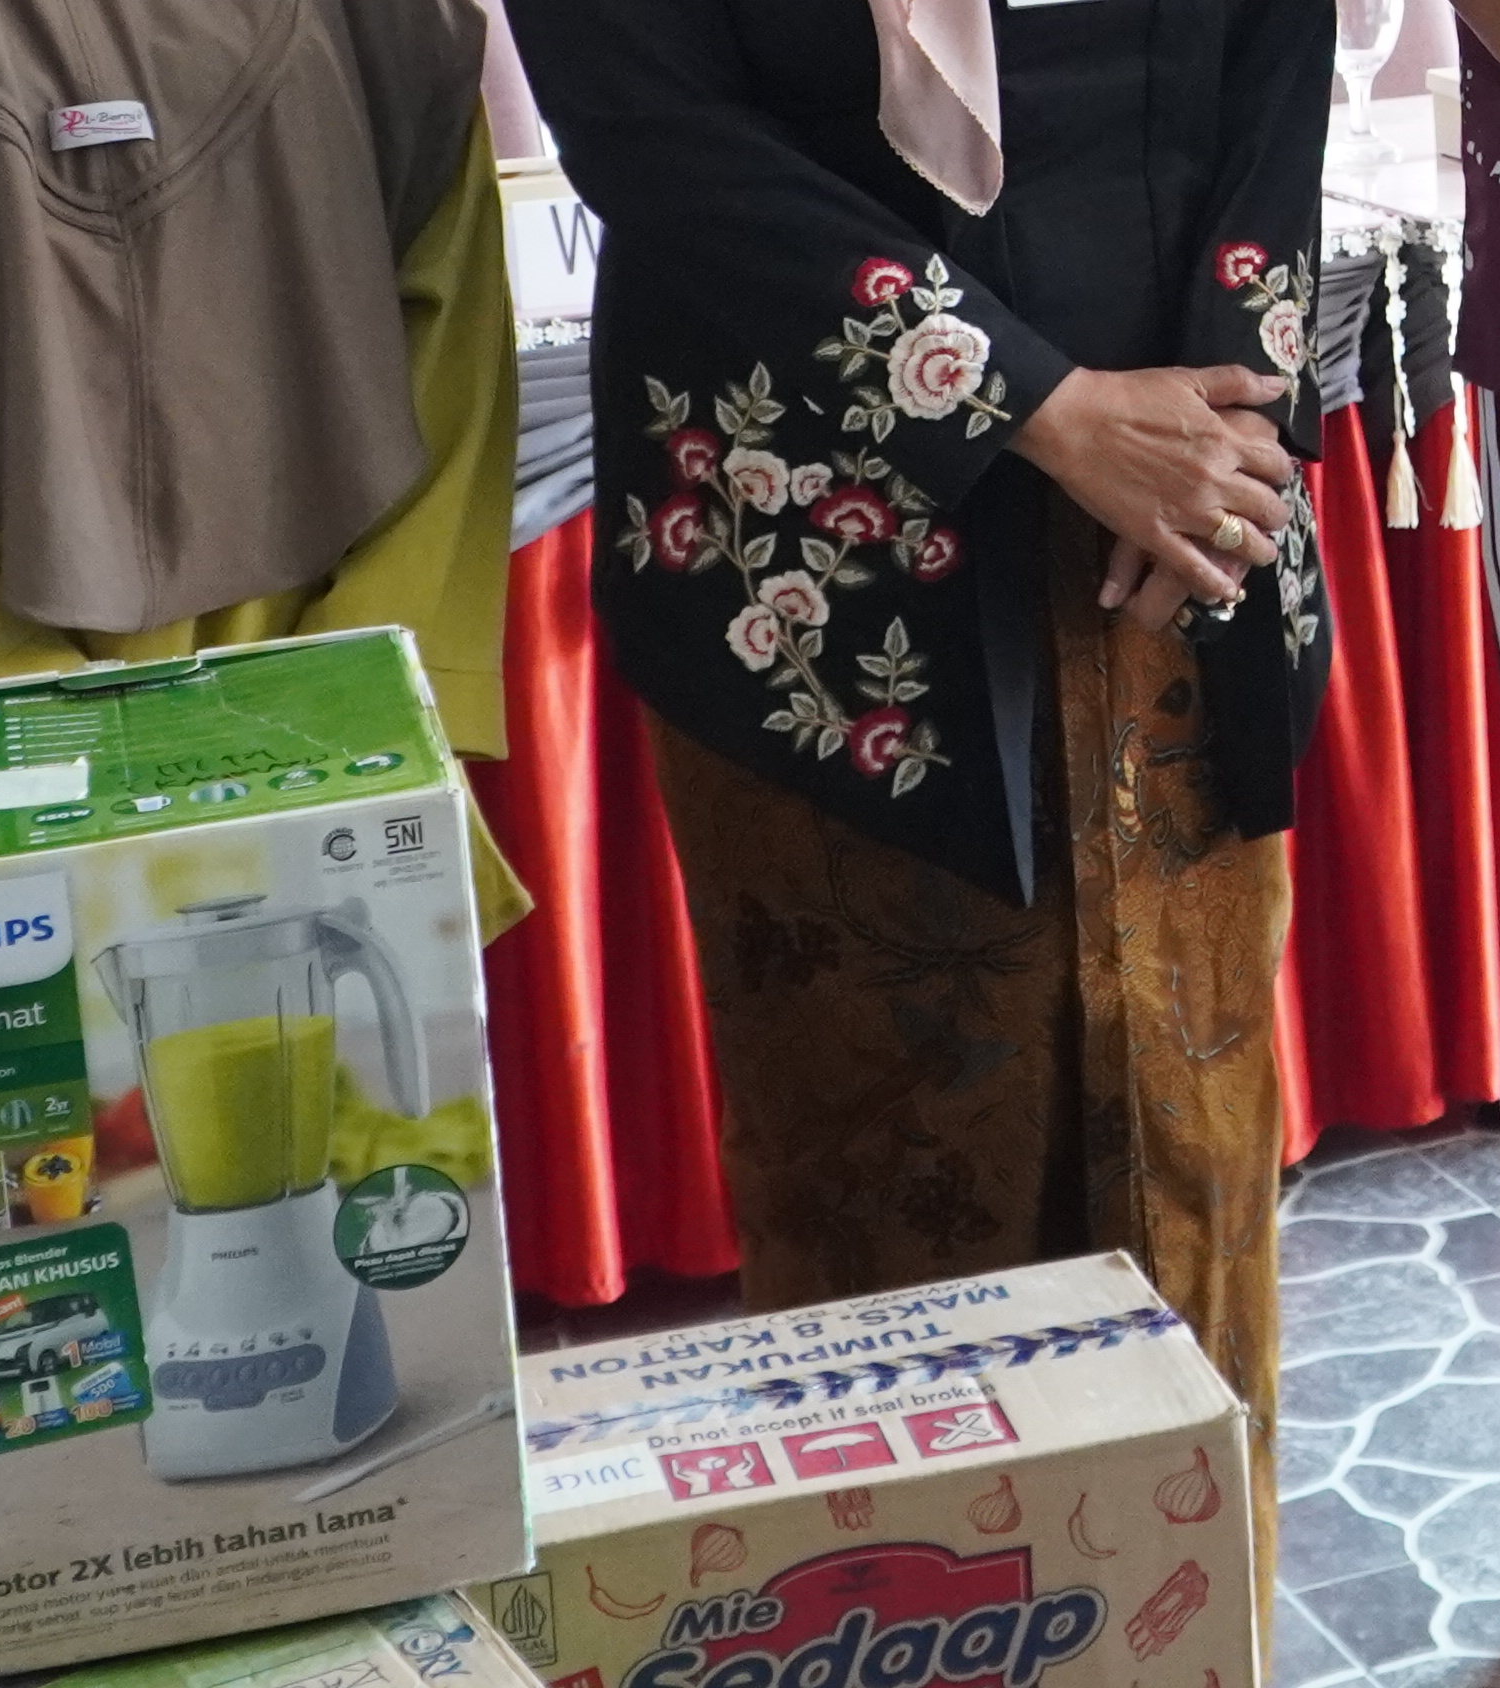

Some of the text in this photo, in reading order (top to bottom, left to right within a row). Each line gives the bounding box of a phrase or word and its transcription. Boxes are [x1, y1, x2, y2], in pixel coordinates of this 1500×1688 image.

[384, 819, 423, 850] SNI
[14, 1246, 68, 1267] Blender
[34, 1251, 120, 1285] KHUSUS
[385, 1248, 415, 1265] dapat
[842, 1284, 1011, 1327] MAKS.
[793, 1321, 824, 1338] 8
[61, 1340, 82, 1369] 1
[82, 1335, 122, 1355] Mobil
[551, 1329, 777, 1384] KARTON
[641, 1321, 953, 1390] TUMPUKAN
[649, 1434, 682, 1451] Do
[689, 1425, 730, 1443] not
[739, 1411, 822, 1436] accept
[854, 1396, 904, 1417] seal
[542, 1457, 645, 1494] JUICE
[70, 1553, 114, 1583] 2X
[123, 1536, 205, 1573] lebih
[214, 1519, 308, 1556] tahan
[666, 1592, 784, 1649] Mie
